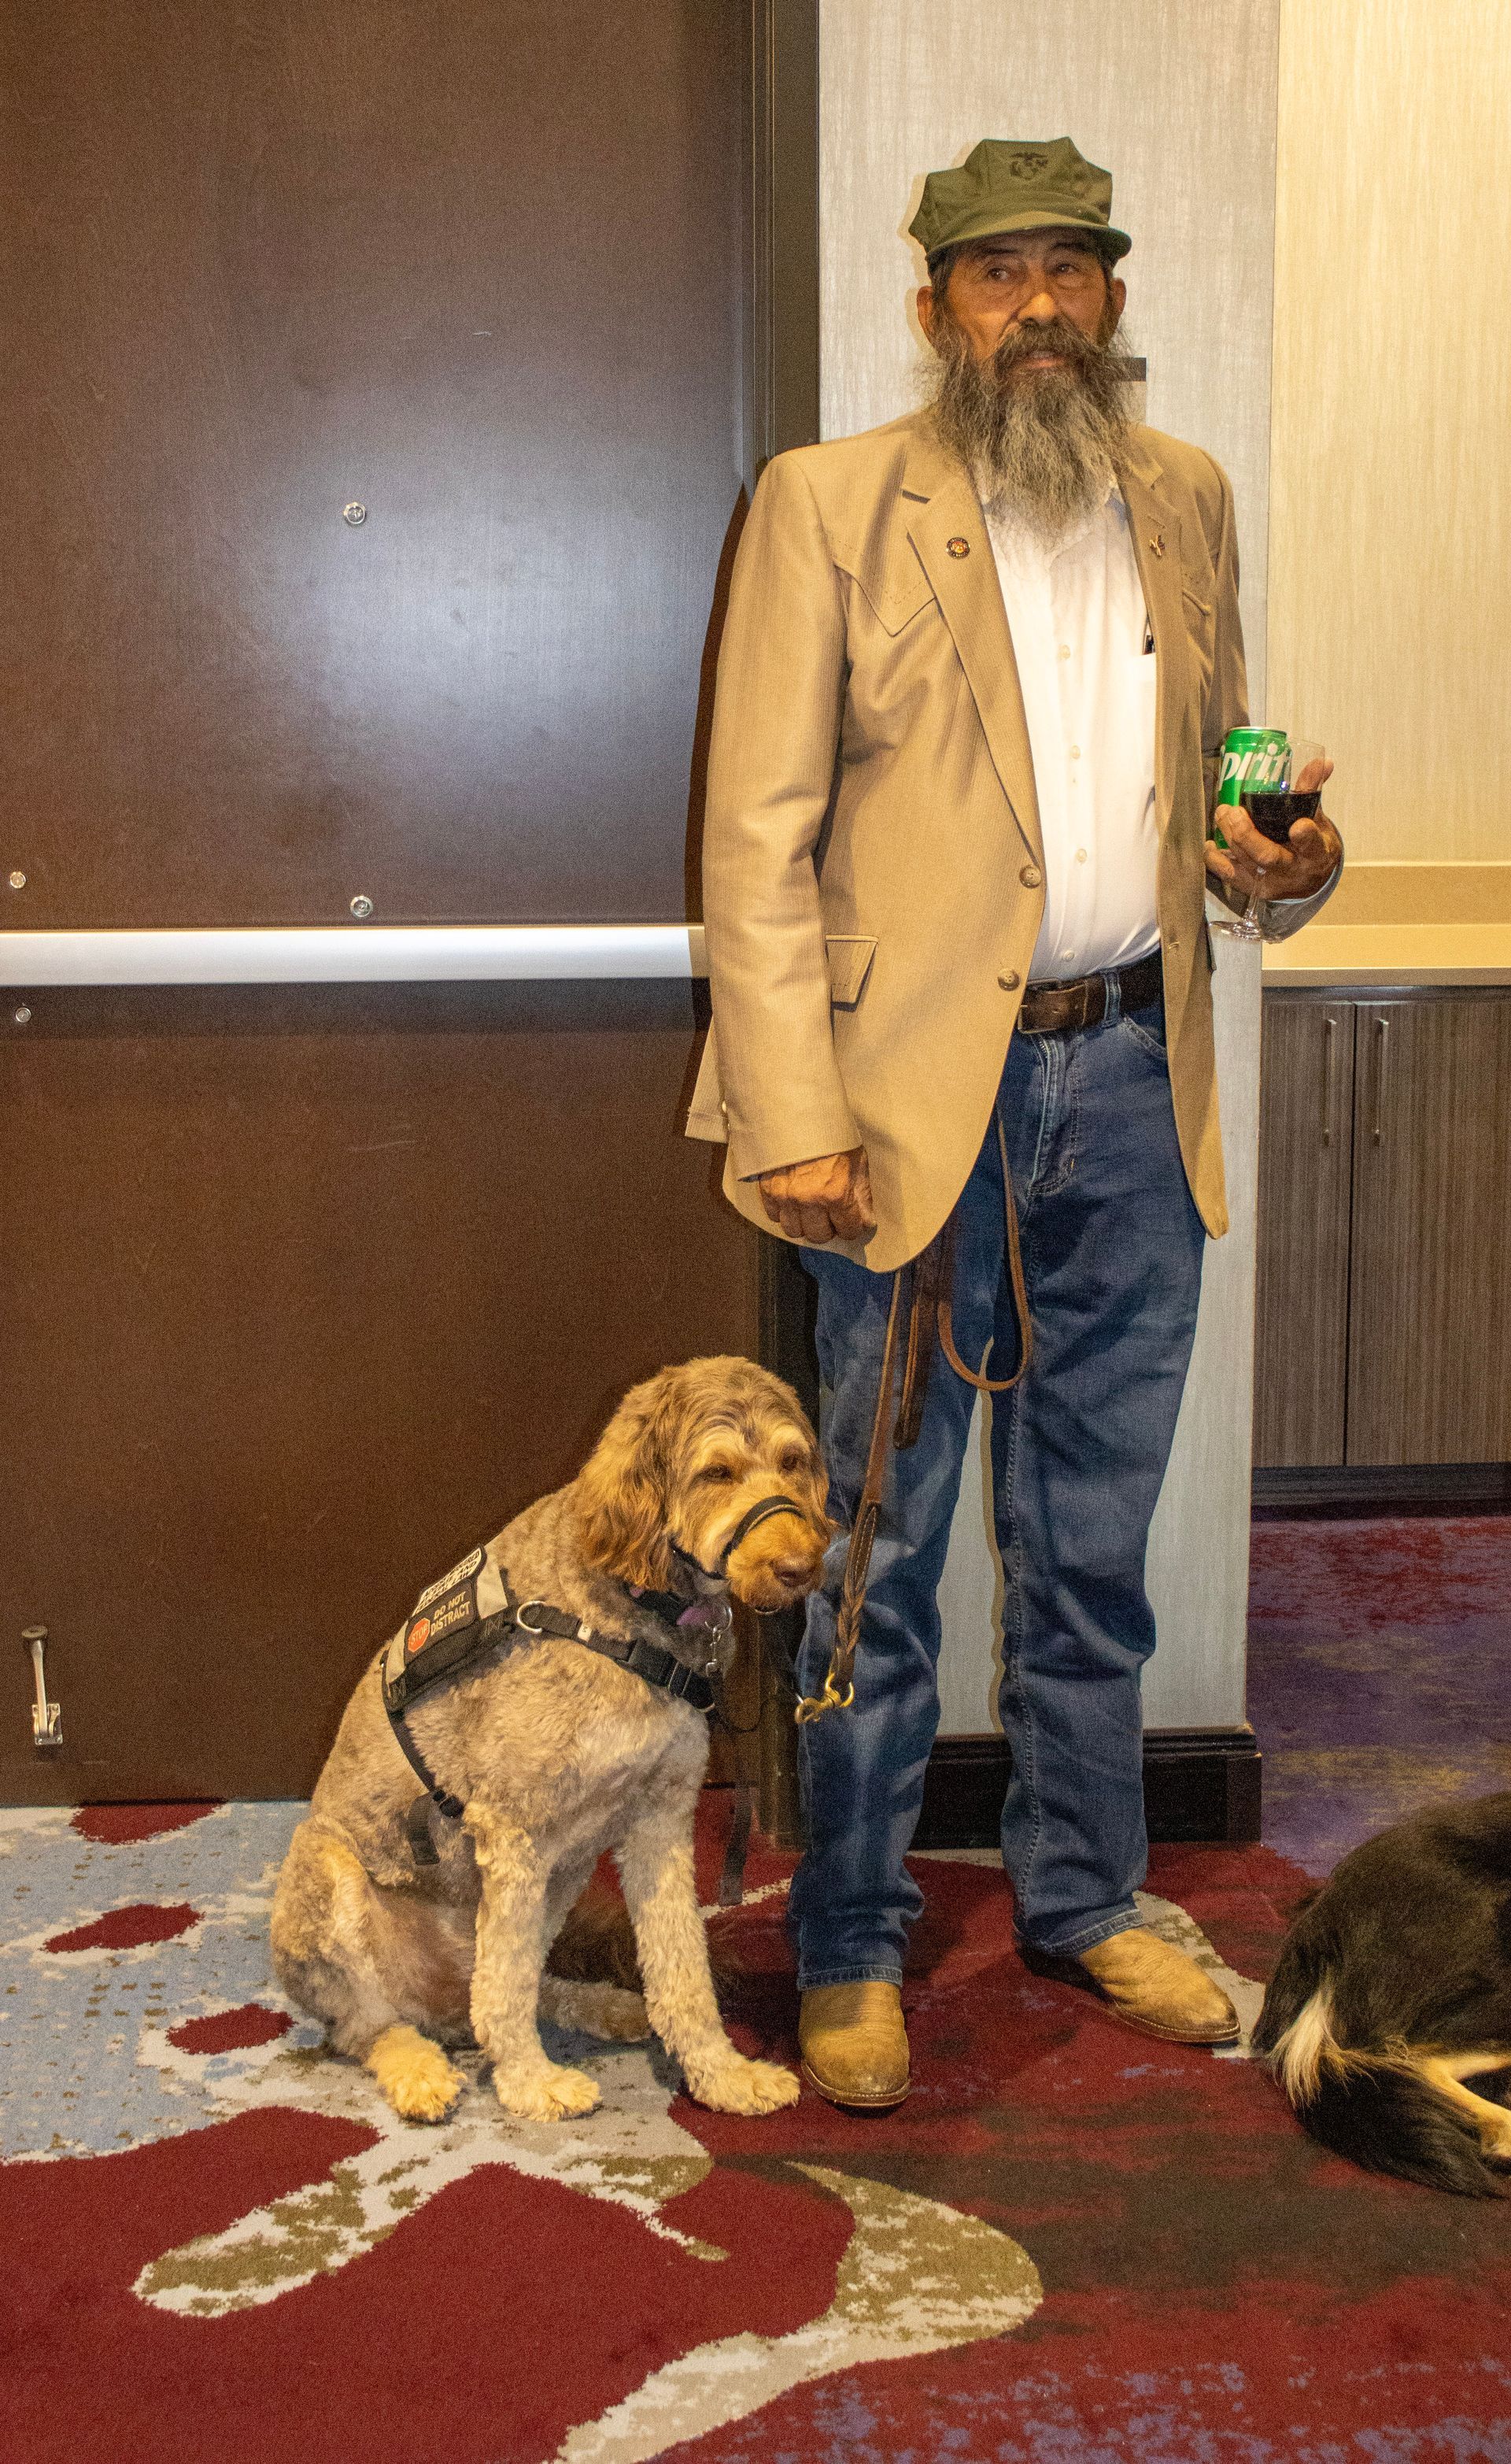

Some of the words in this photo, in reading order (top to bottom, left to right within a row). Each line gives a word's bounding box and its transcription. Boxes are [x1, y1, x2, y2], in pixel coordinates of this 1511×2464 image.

[1219, 742, 1289, 791] prit
[430, 1600, 471, 1636] DISTRACT
[434, 1605, 446, 1620] DO
[448, 1591, 466, 1611] NOT
[411, 1623, 429, 1645] STOP
